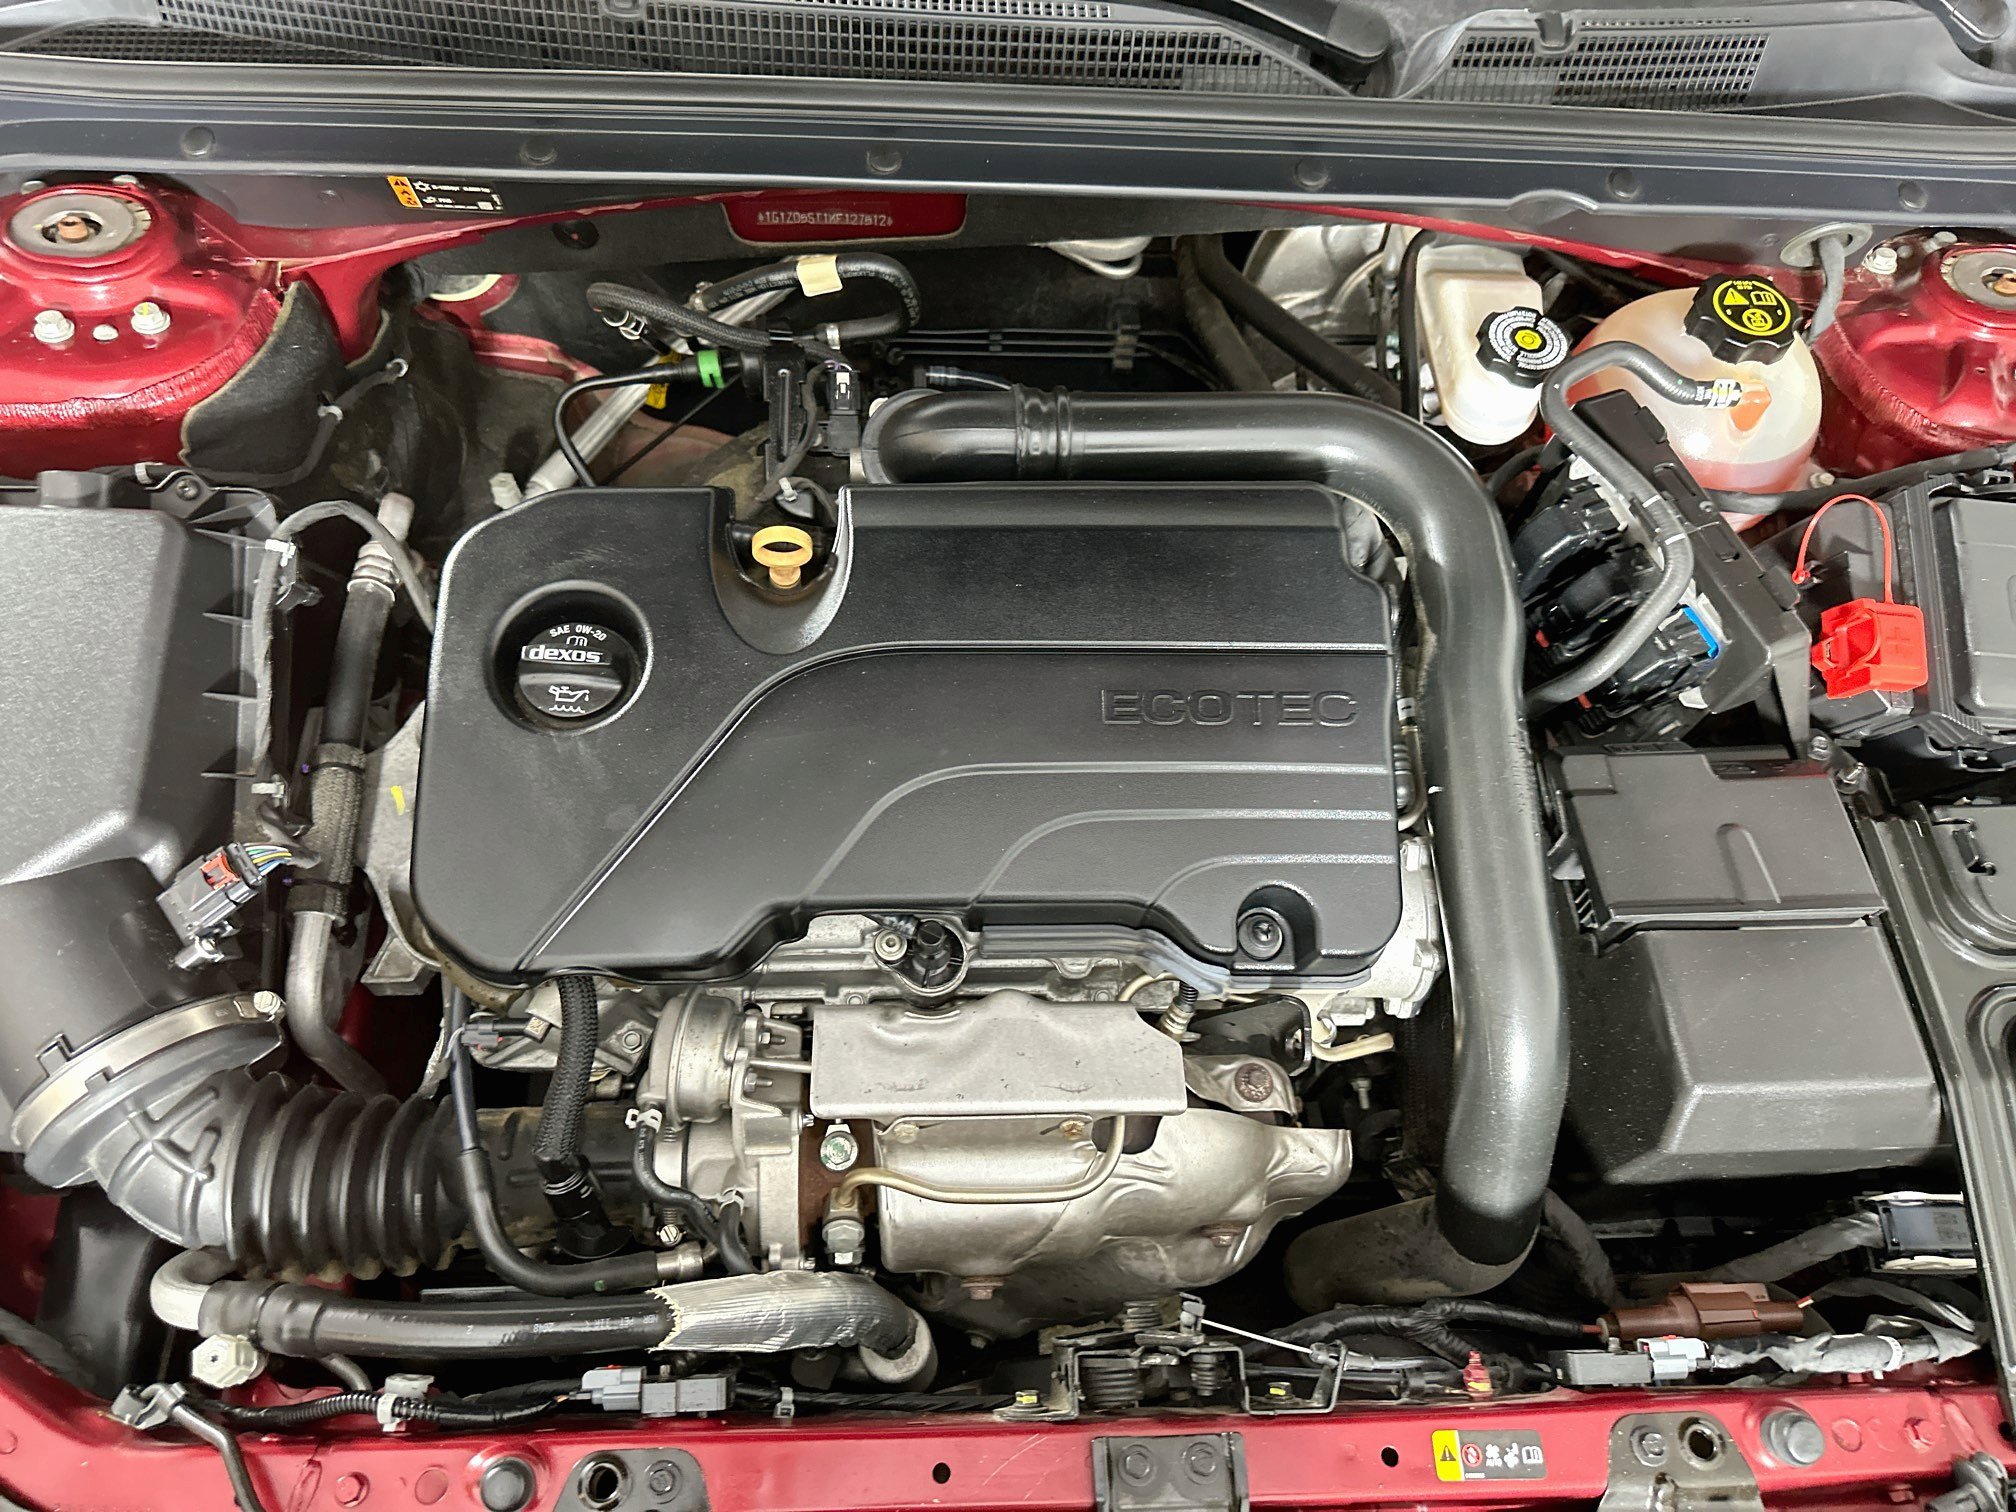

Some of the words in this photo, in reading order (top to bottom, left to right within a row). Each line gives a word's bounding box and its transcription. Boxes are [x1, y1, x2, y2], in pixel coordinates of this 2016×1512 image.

[550, 625, 570, 638] SAE
[575, 624, 607, 641] 0W-20
[529, 644, 604, 664] dexos
[1101, 689, 1359, 728] ECOTEC
